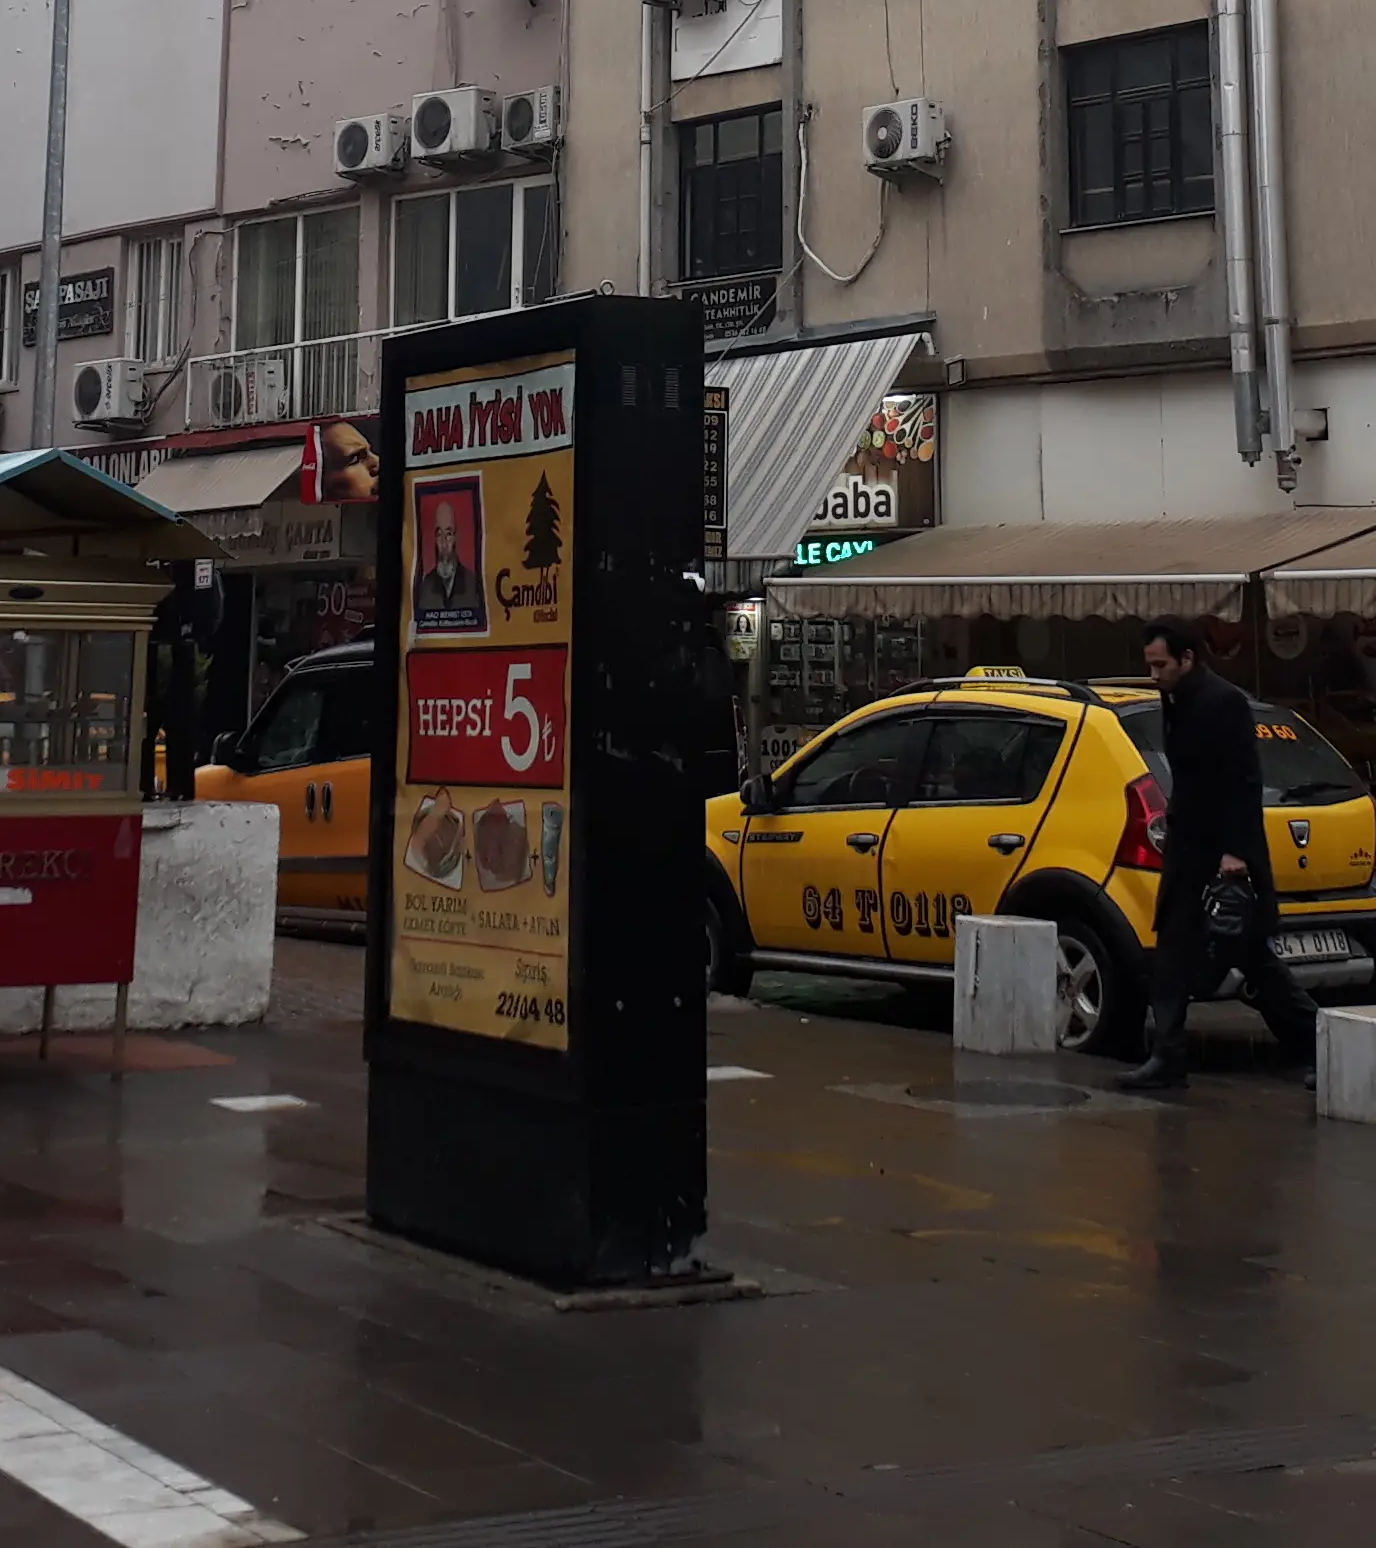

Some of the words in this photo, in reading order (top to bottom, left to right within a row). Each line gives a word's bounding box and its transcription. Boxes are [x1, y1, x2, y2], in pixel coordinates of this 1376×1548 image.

[411, 404, 464, 457] DAHA
[467, 385, 523, 450] İYİSİ
[527, 386, 567, 441] YOK
[416, 688, 494, 738] HEPSİ
[802, 883, 844, 930] 64
[854, 888, 879, 934] T
[1298, 932, 1308, 954] T
[1313, 927, 1346, 952] 0118
